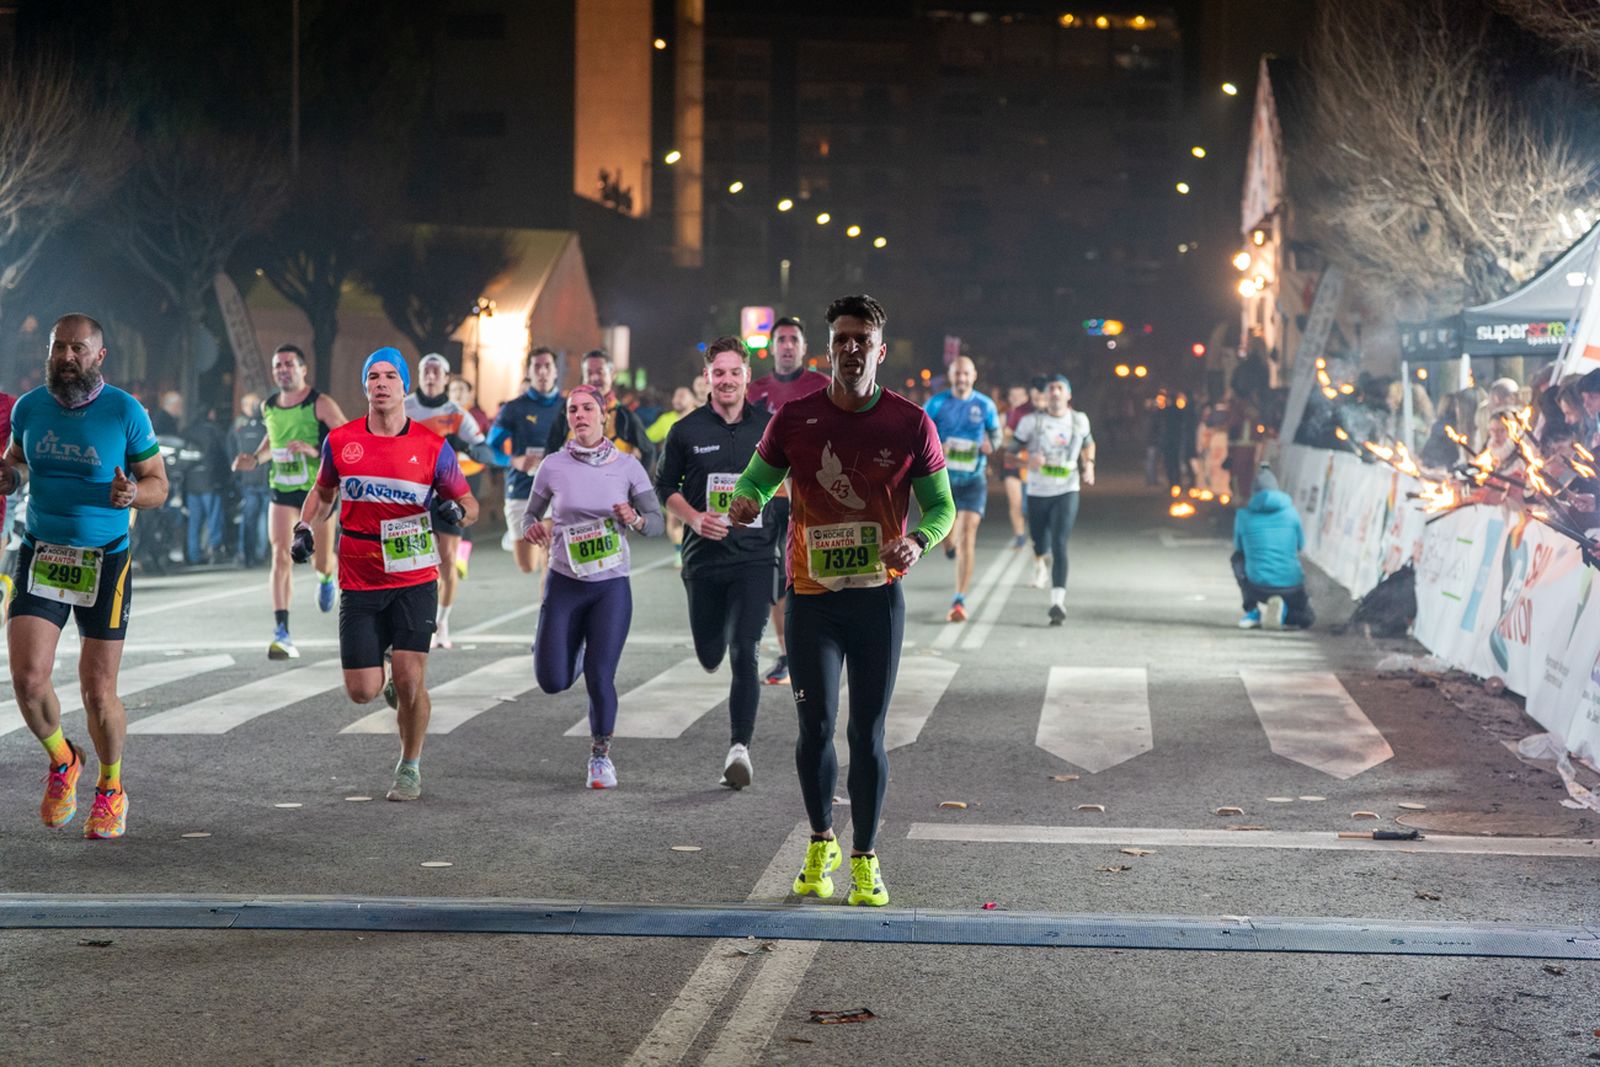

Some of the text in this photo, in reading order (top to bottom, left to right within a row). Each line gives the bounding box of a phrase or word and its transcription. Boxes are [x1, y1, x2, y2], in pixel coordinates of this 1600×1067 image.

[36, 441, 100, 459] ULTRA
[831, 479, 849, 499] 43
[388, 529, 401, 538] SAN
[822, 530, 844, 539] NOCHE
[846, 529, 855, 537] DE
[571, 535, 583, 543] SAN
[579, 535, 613, 558] 8746
[815, 540, 830, 549] SAN
[48, 548, 77, 557] NOCHE DE
[40, 554, 53, 562] SAN
[822, 546, 869, 570] 7329
[47, 563, 82, 584] 299
